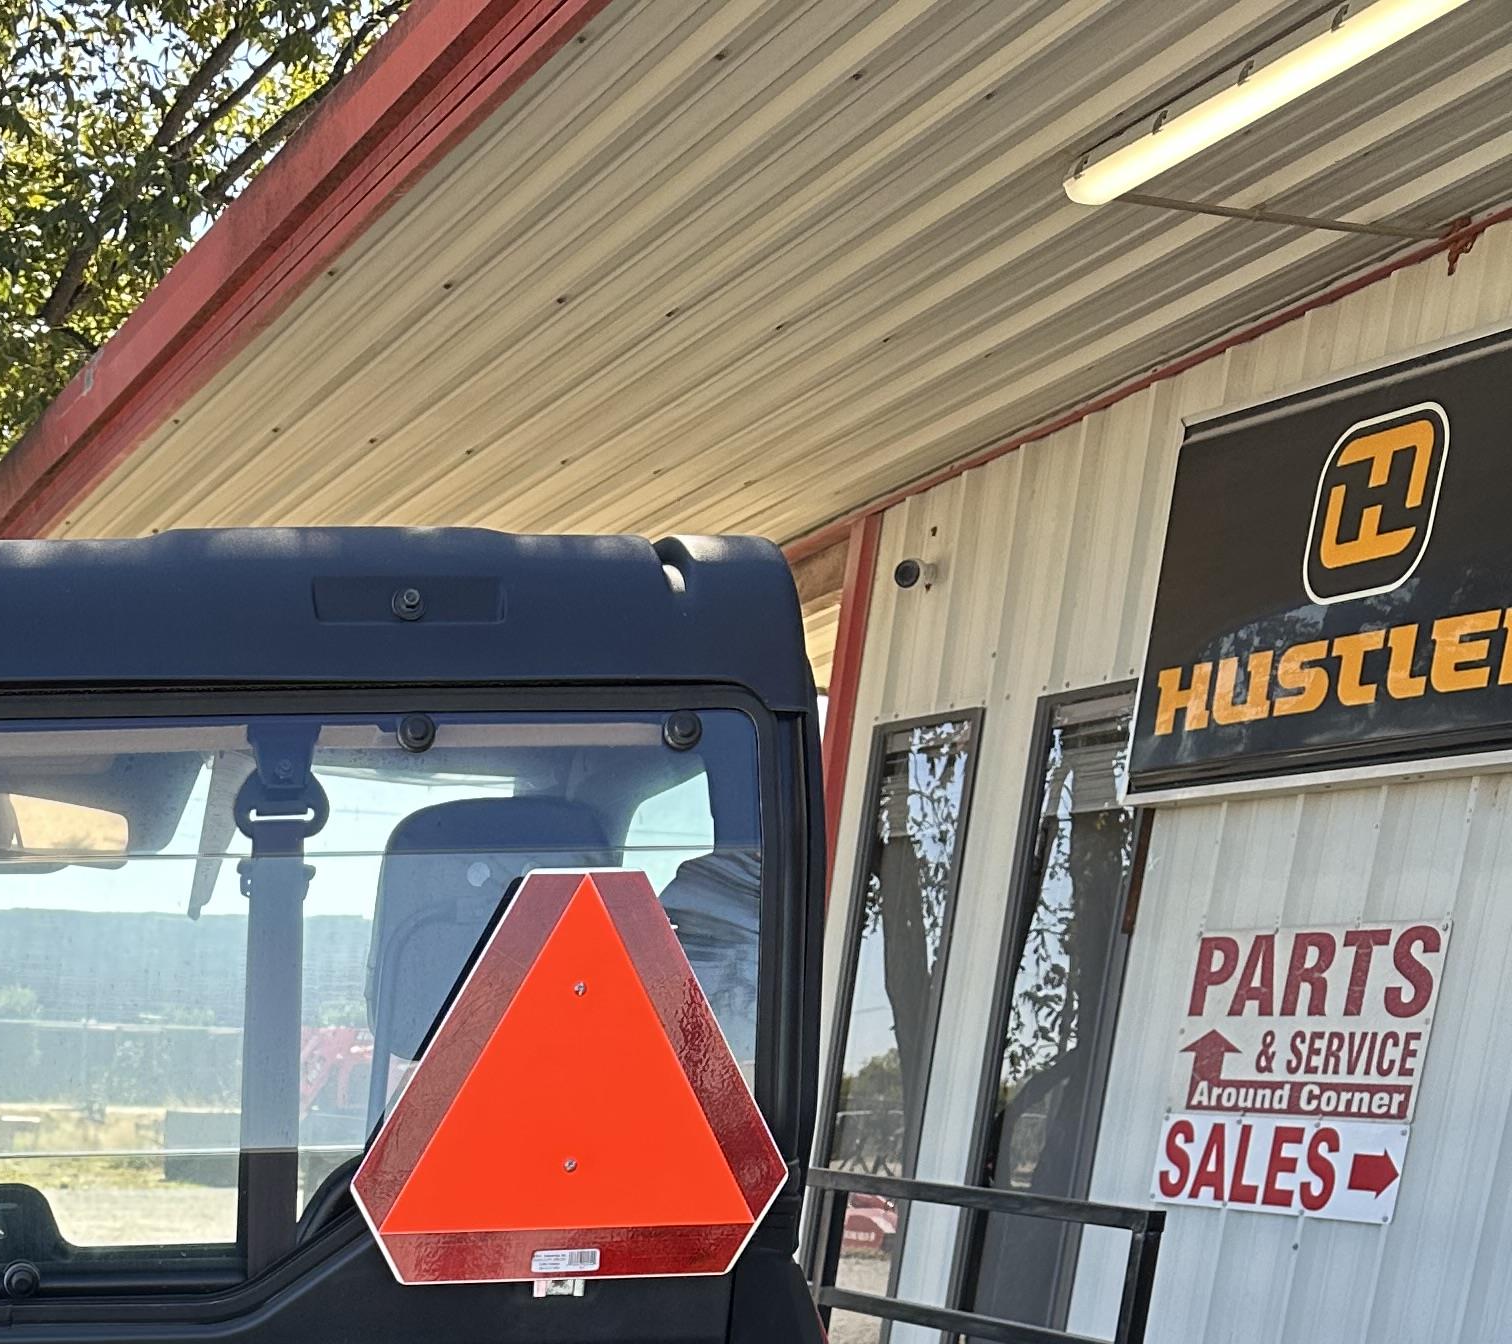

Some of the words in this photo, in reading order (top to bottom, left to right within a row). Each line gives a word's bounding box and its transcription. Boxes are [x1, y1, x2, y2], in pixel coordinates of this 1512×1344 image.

[1154, 607, 1512, 736] HUSTLE
[1188, 925, 1441, 1018] PARTS
[1191, 1080, 1291, 1110] Around
[1299, 1084, 1405, 1114] Corner
[1255, 1030, 1277, 1074] &
[1286, 1030, 1422, 1077] SERVICE
[1159, 1119, 1340, 1211] SALES
